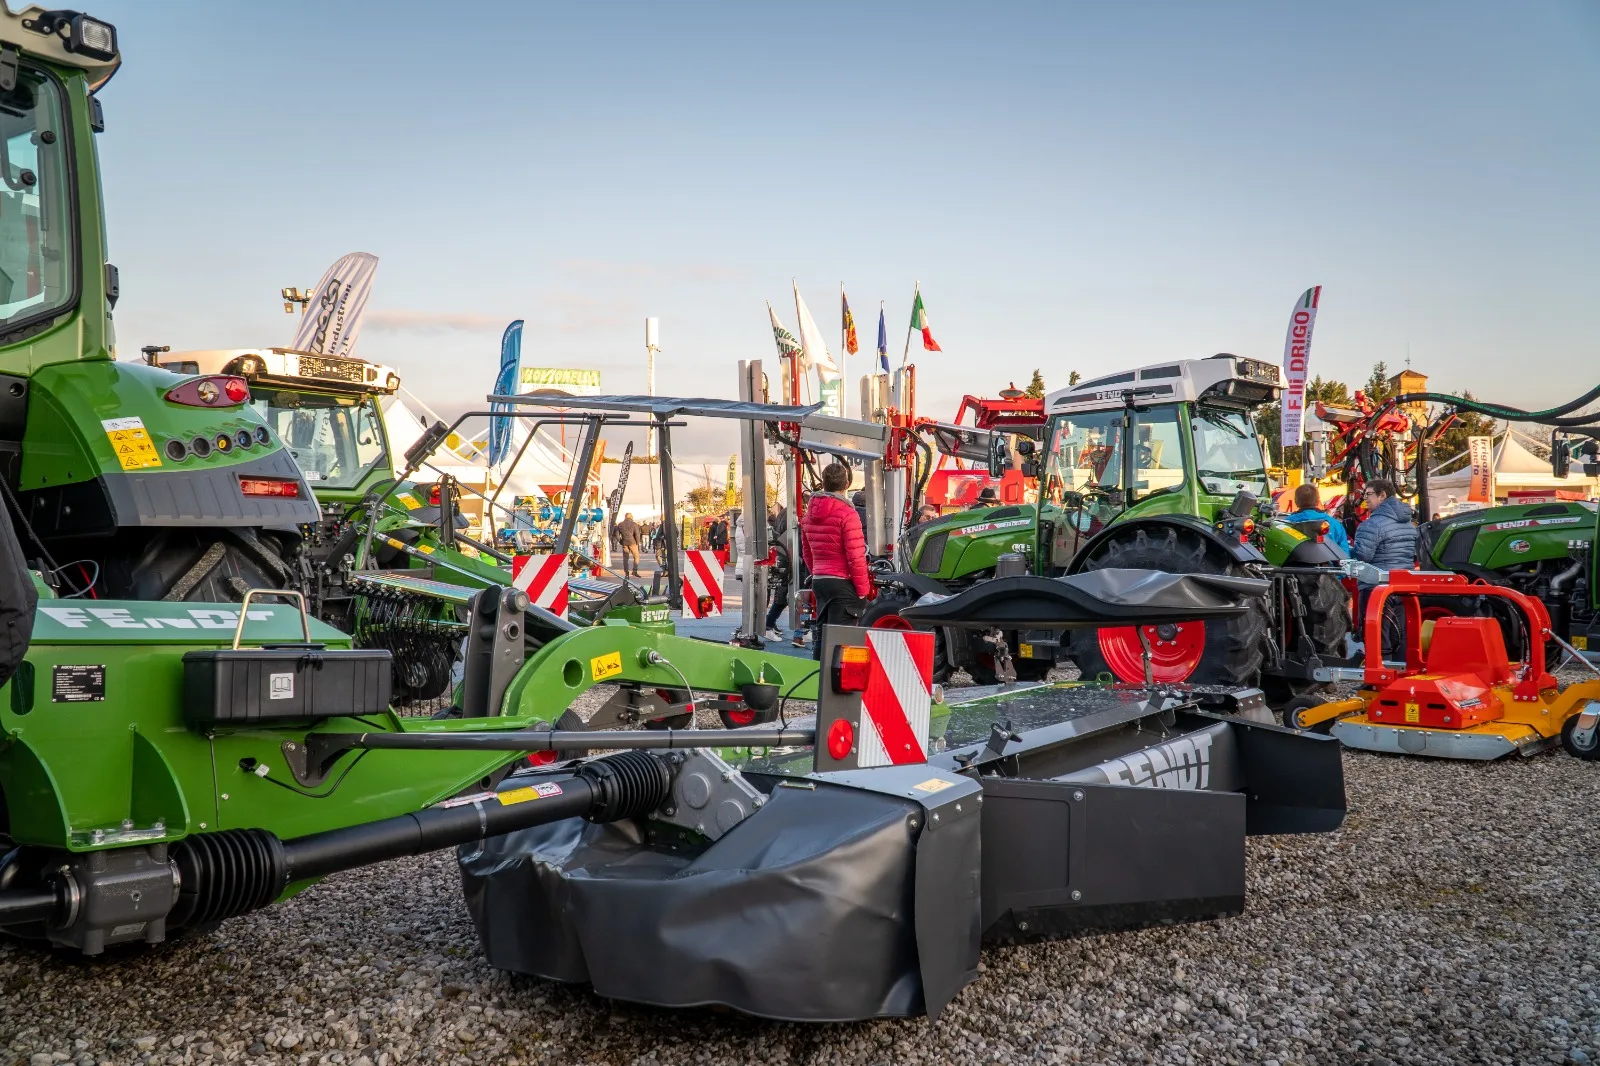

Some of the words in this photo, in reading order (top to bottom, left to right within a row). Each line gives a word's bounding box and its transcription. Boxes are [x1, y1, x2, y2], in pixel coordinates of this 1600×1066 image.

[1290, 312, 1310, 372] DRIGO
[1096, 390, 1122, 400] FEND
[1480, 438, 1488, 497] Irrigazione
[961, 524, 990, 535] FENDT
[1496, 520, 1533, 530] FENDT
[37, 607, 275, 629] FENDT
[641, 609, 670, 622] FENDT
[1094, 733, 1213, 790] FENDT
